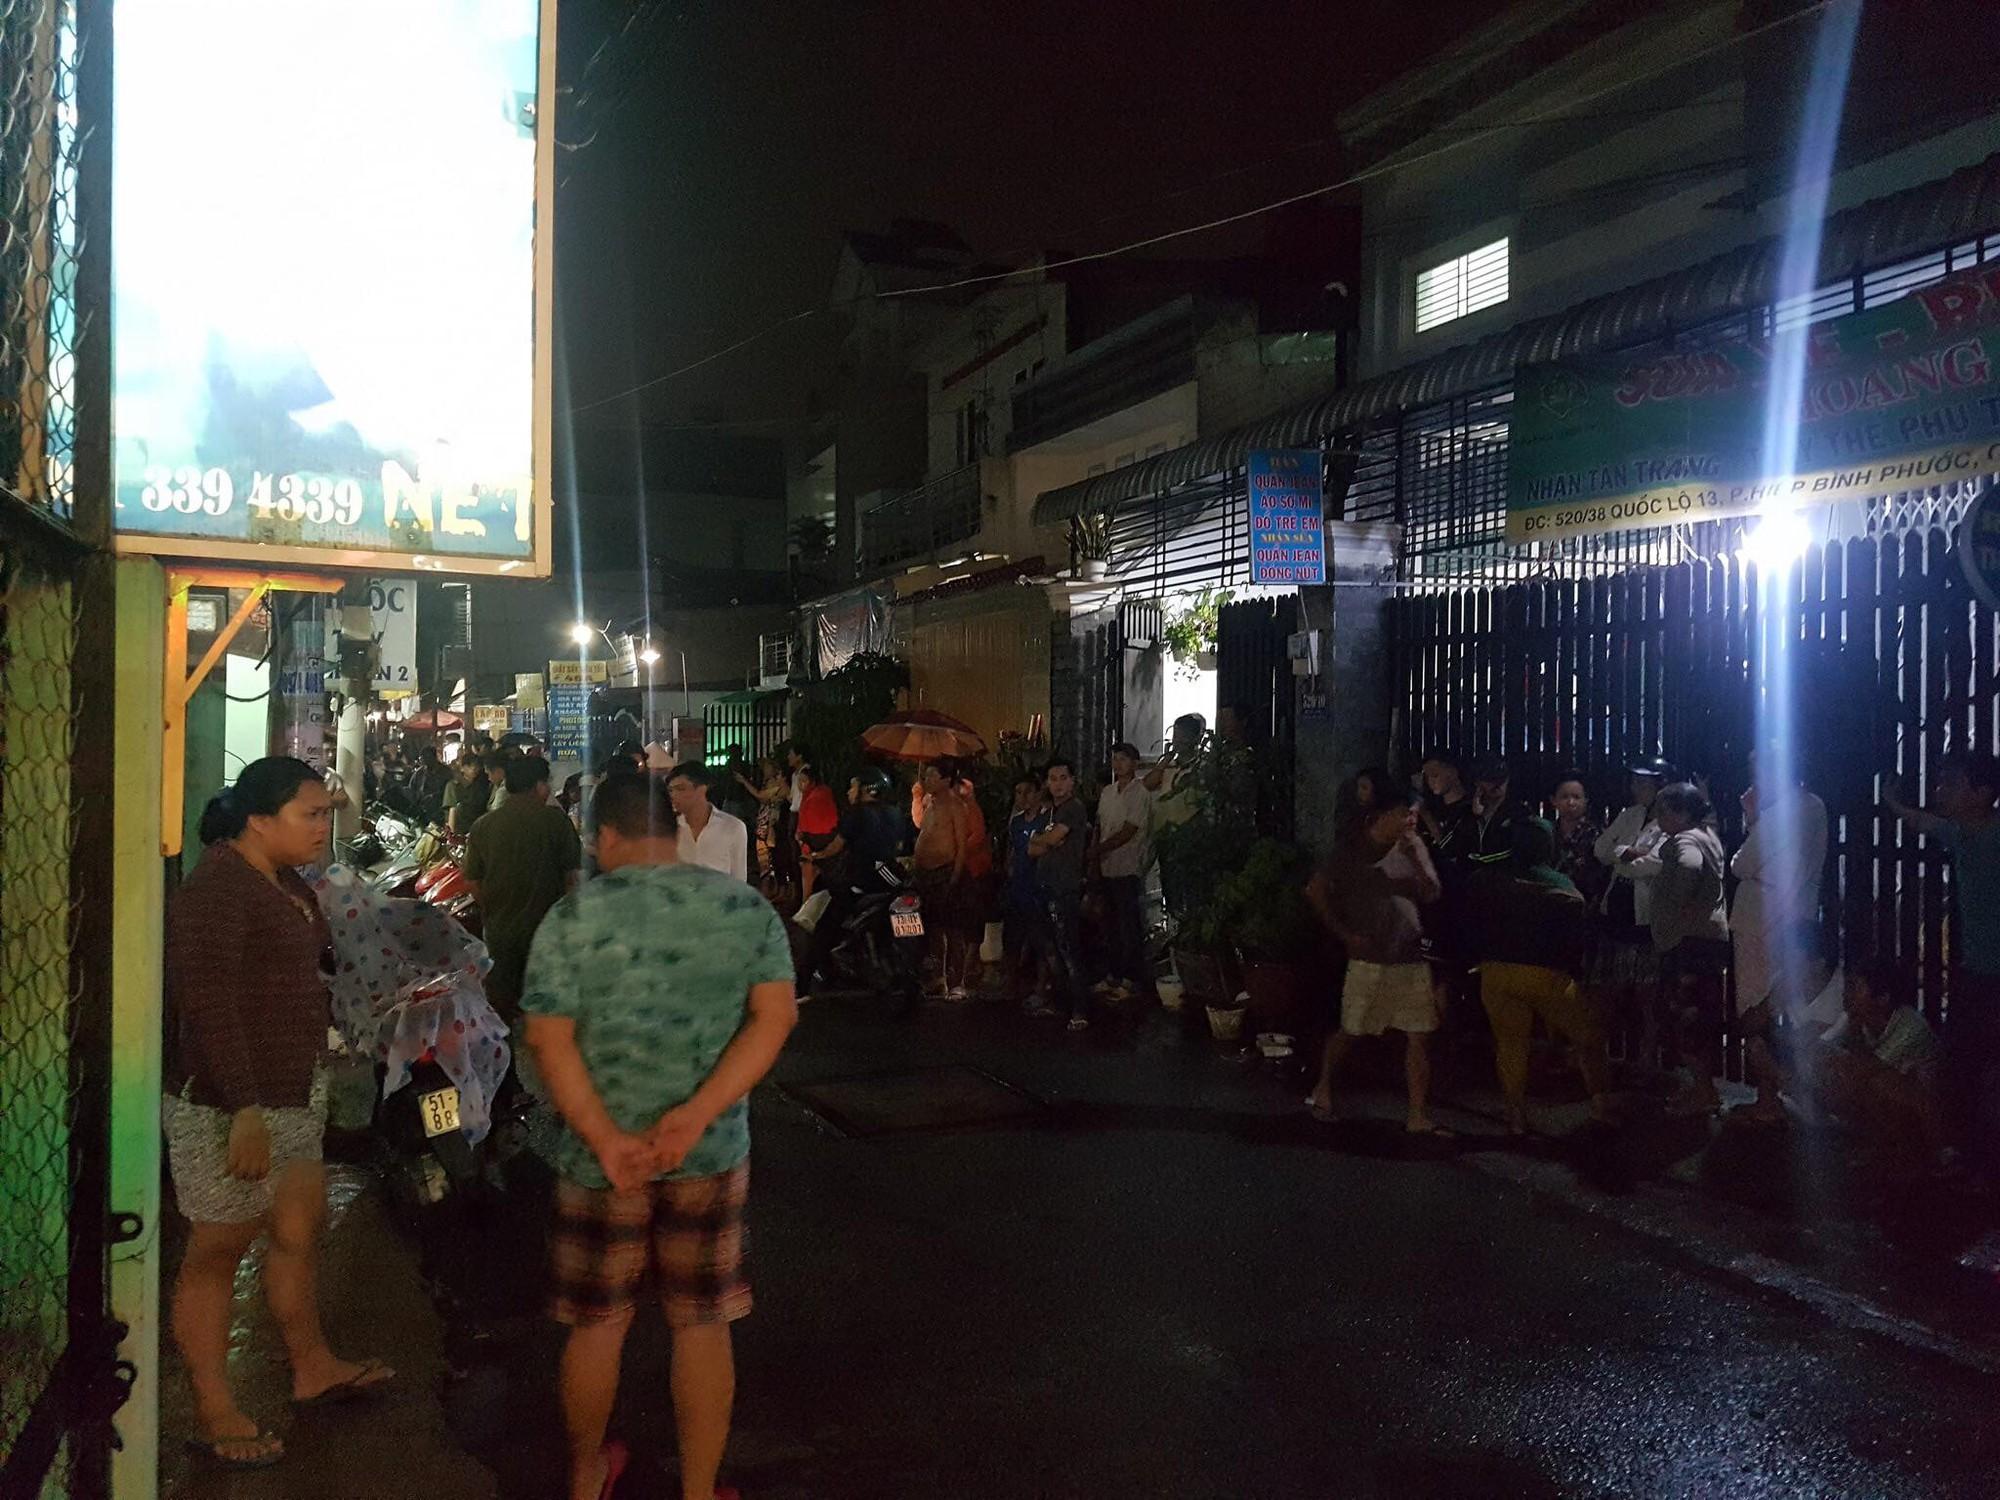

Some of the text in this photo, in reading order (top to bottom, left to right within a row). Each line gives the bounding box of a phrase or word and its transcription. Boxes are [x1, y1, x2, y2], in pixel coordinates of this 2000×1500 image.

[141, 466, 234, 517] 339
[246, 471, 363, 526] 4339
[1555, 506, 1606, 527] 520/38
[1610, 494, 1662, 519] QUỐC
[1668, 490, 1692, 514] LỘ
[1812, 469, 1872, 492] BÌNH
[1302, 516, 1319, 530] EM
[1292, 549, 1319, 562] JEAN
